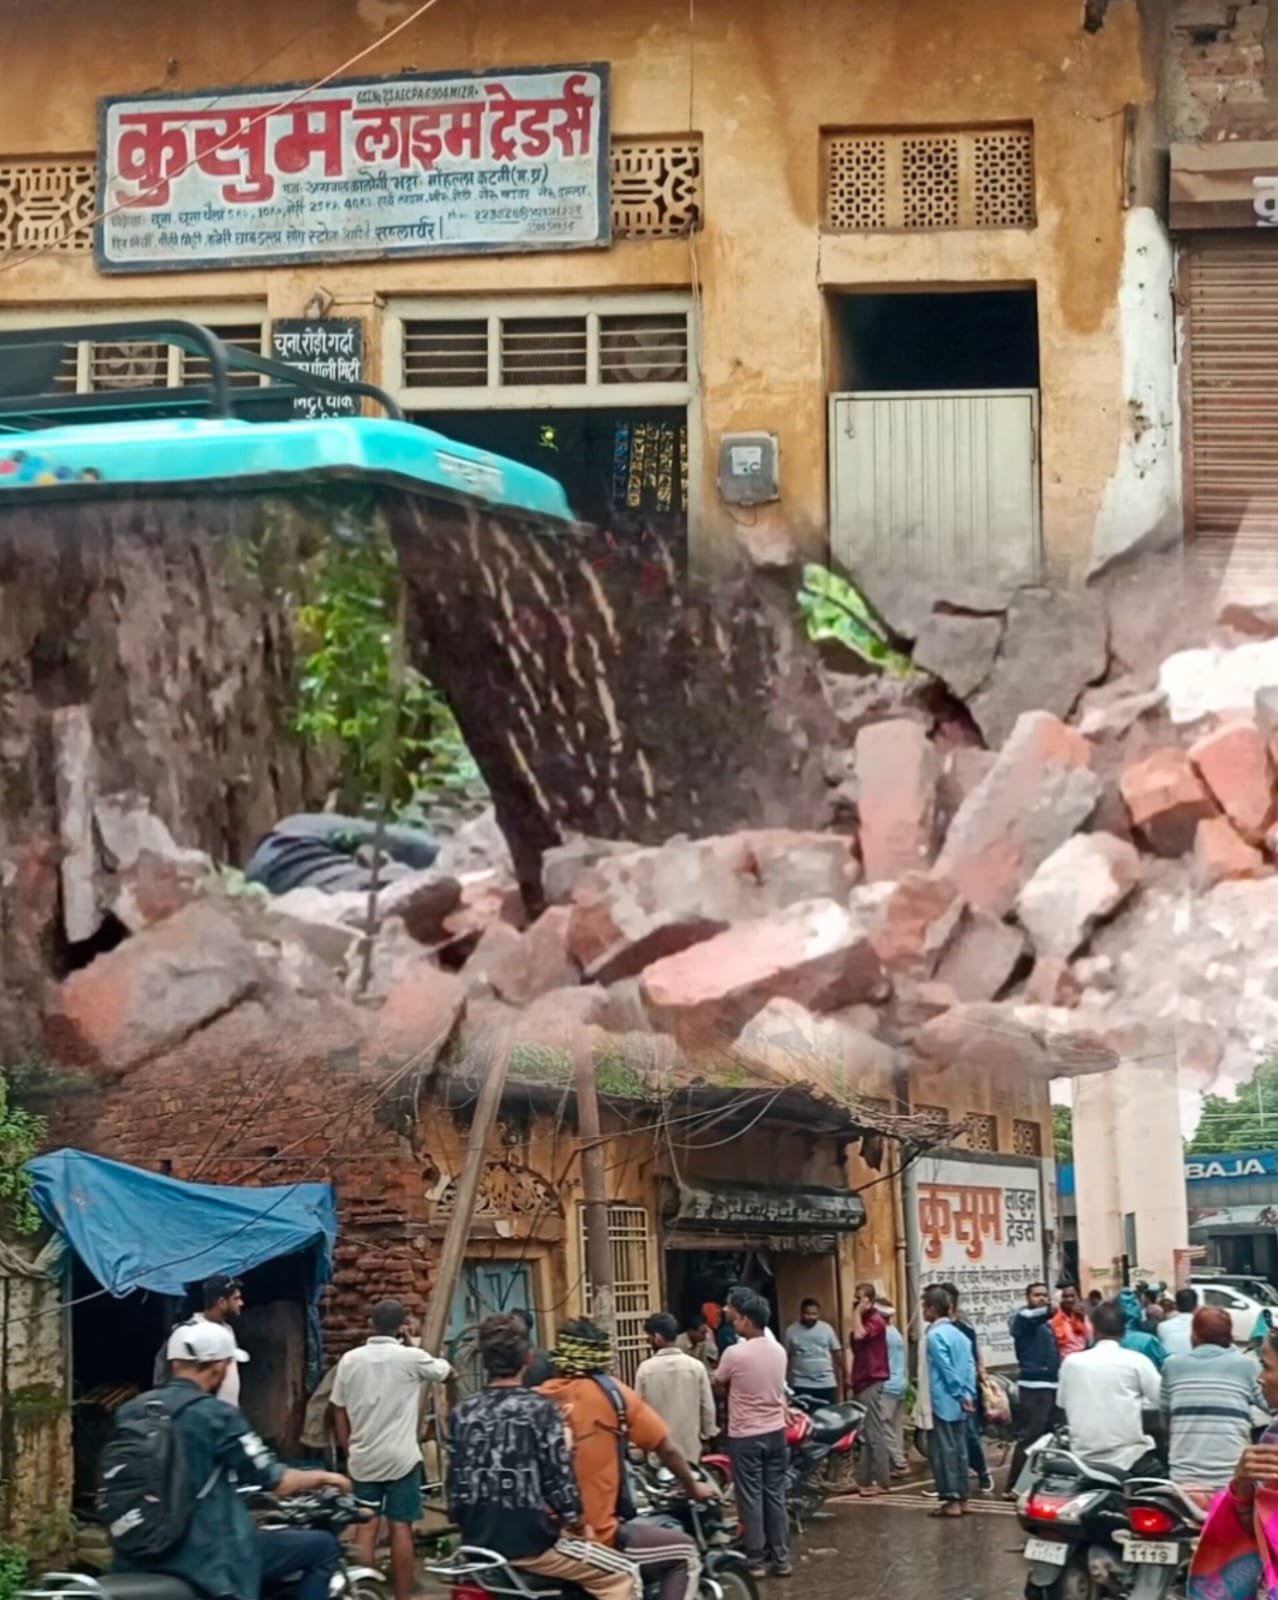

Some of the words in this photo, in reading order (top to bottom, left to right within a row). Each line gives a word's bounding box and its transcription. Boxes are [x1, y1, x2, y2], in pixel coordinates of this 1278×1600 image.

[115, 98, 352, 208] कुसुम
[353, 101, 486, 171] लाइम
[485, 74, 594, 161] ट्रेडर्स
[273, 333, 301, 357] चूना
[917, 1182, 1003, 1259] कुसुम
